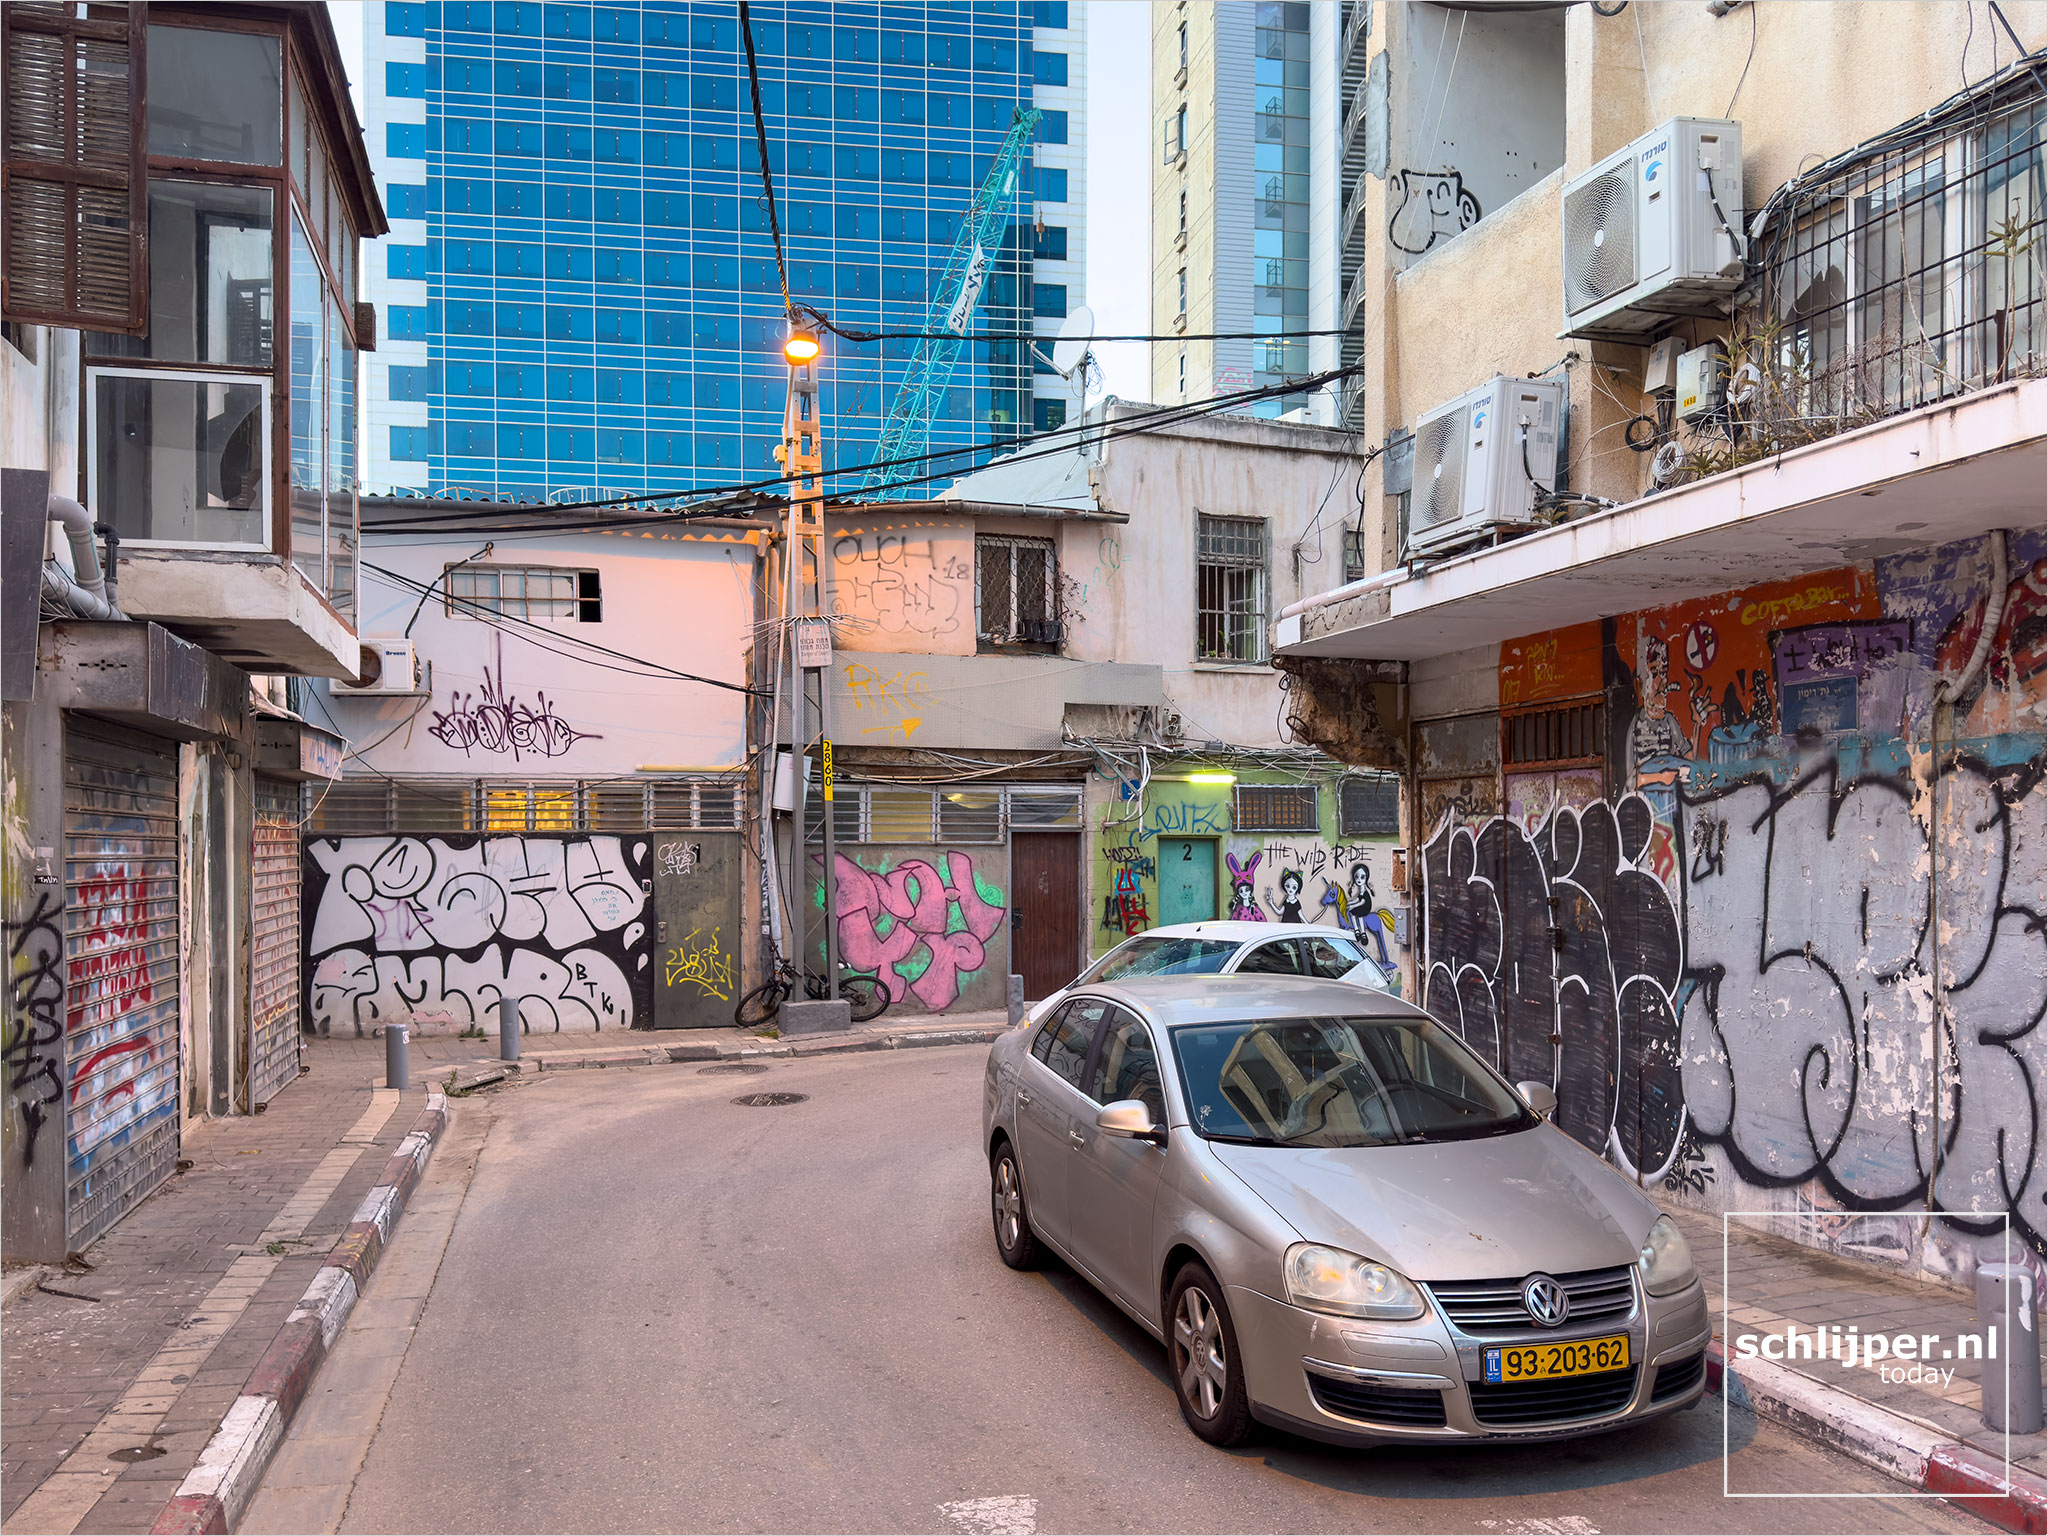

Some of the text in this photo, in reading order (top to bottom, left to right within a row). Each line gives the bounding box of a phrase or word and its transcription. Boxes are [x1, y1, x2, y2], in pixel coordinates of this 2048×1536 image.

[1641, 141, 1667, 162] טורנדו
[1472, 396, 1492, 411] טורנדו
[823, 741, 832, 787] 2860
[1182, 844, 1193, 861] 2
